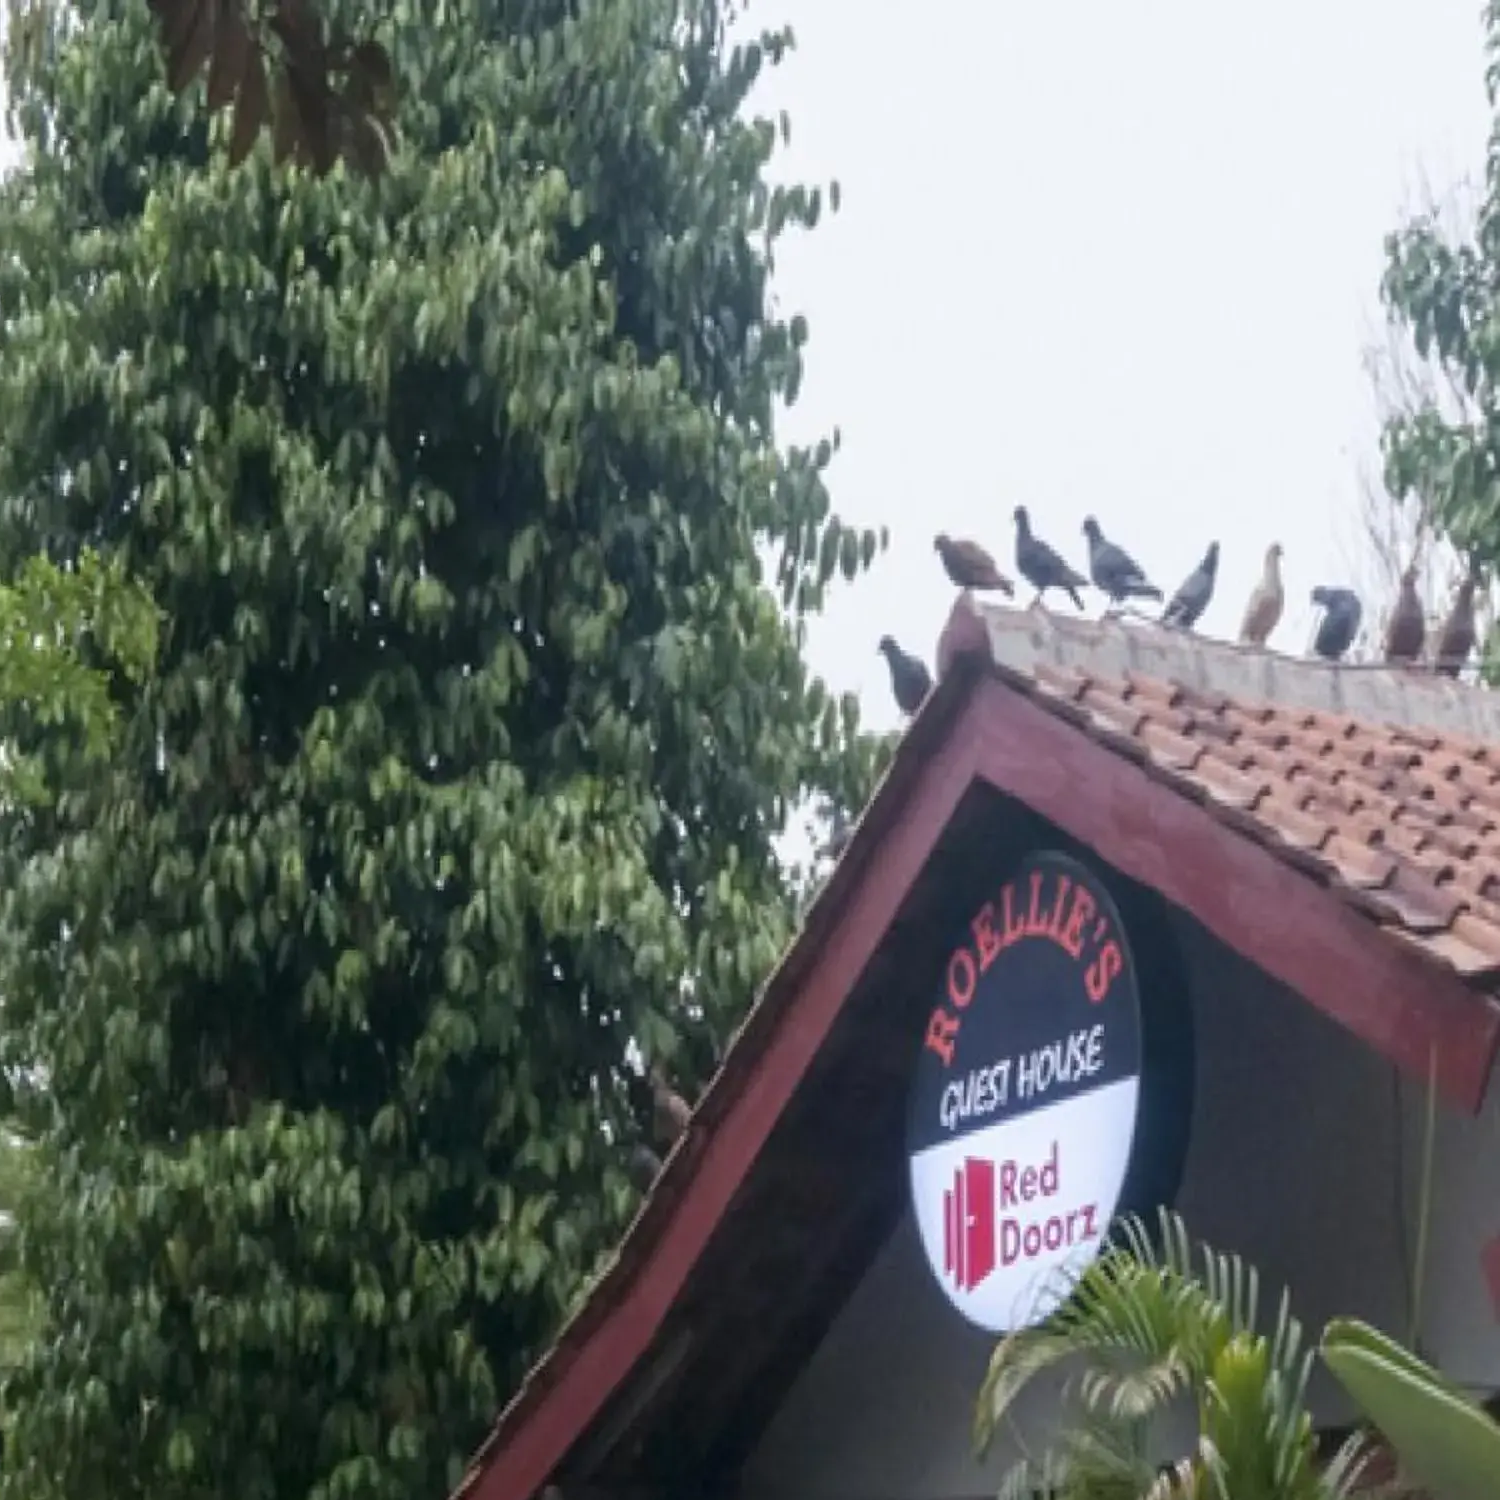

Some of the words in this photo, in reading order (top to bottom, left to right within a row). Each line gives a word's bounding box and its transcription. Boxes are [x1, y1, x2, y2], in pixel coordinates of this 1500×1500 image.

[924, 869, 1123, 1067] ROELLIE'S
[940, 1058, 1012, 1131] GUEST
[1018, 1023, 1105, 1098] HOUSE
[1000, 1140, 1059, 1209] Red
[1000, 1204, 1098, 1268] Doorz
